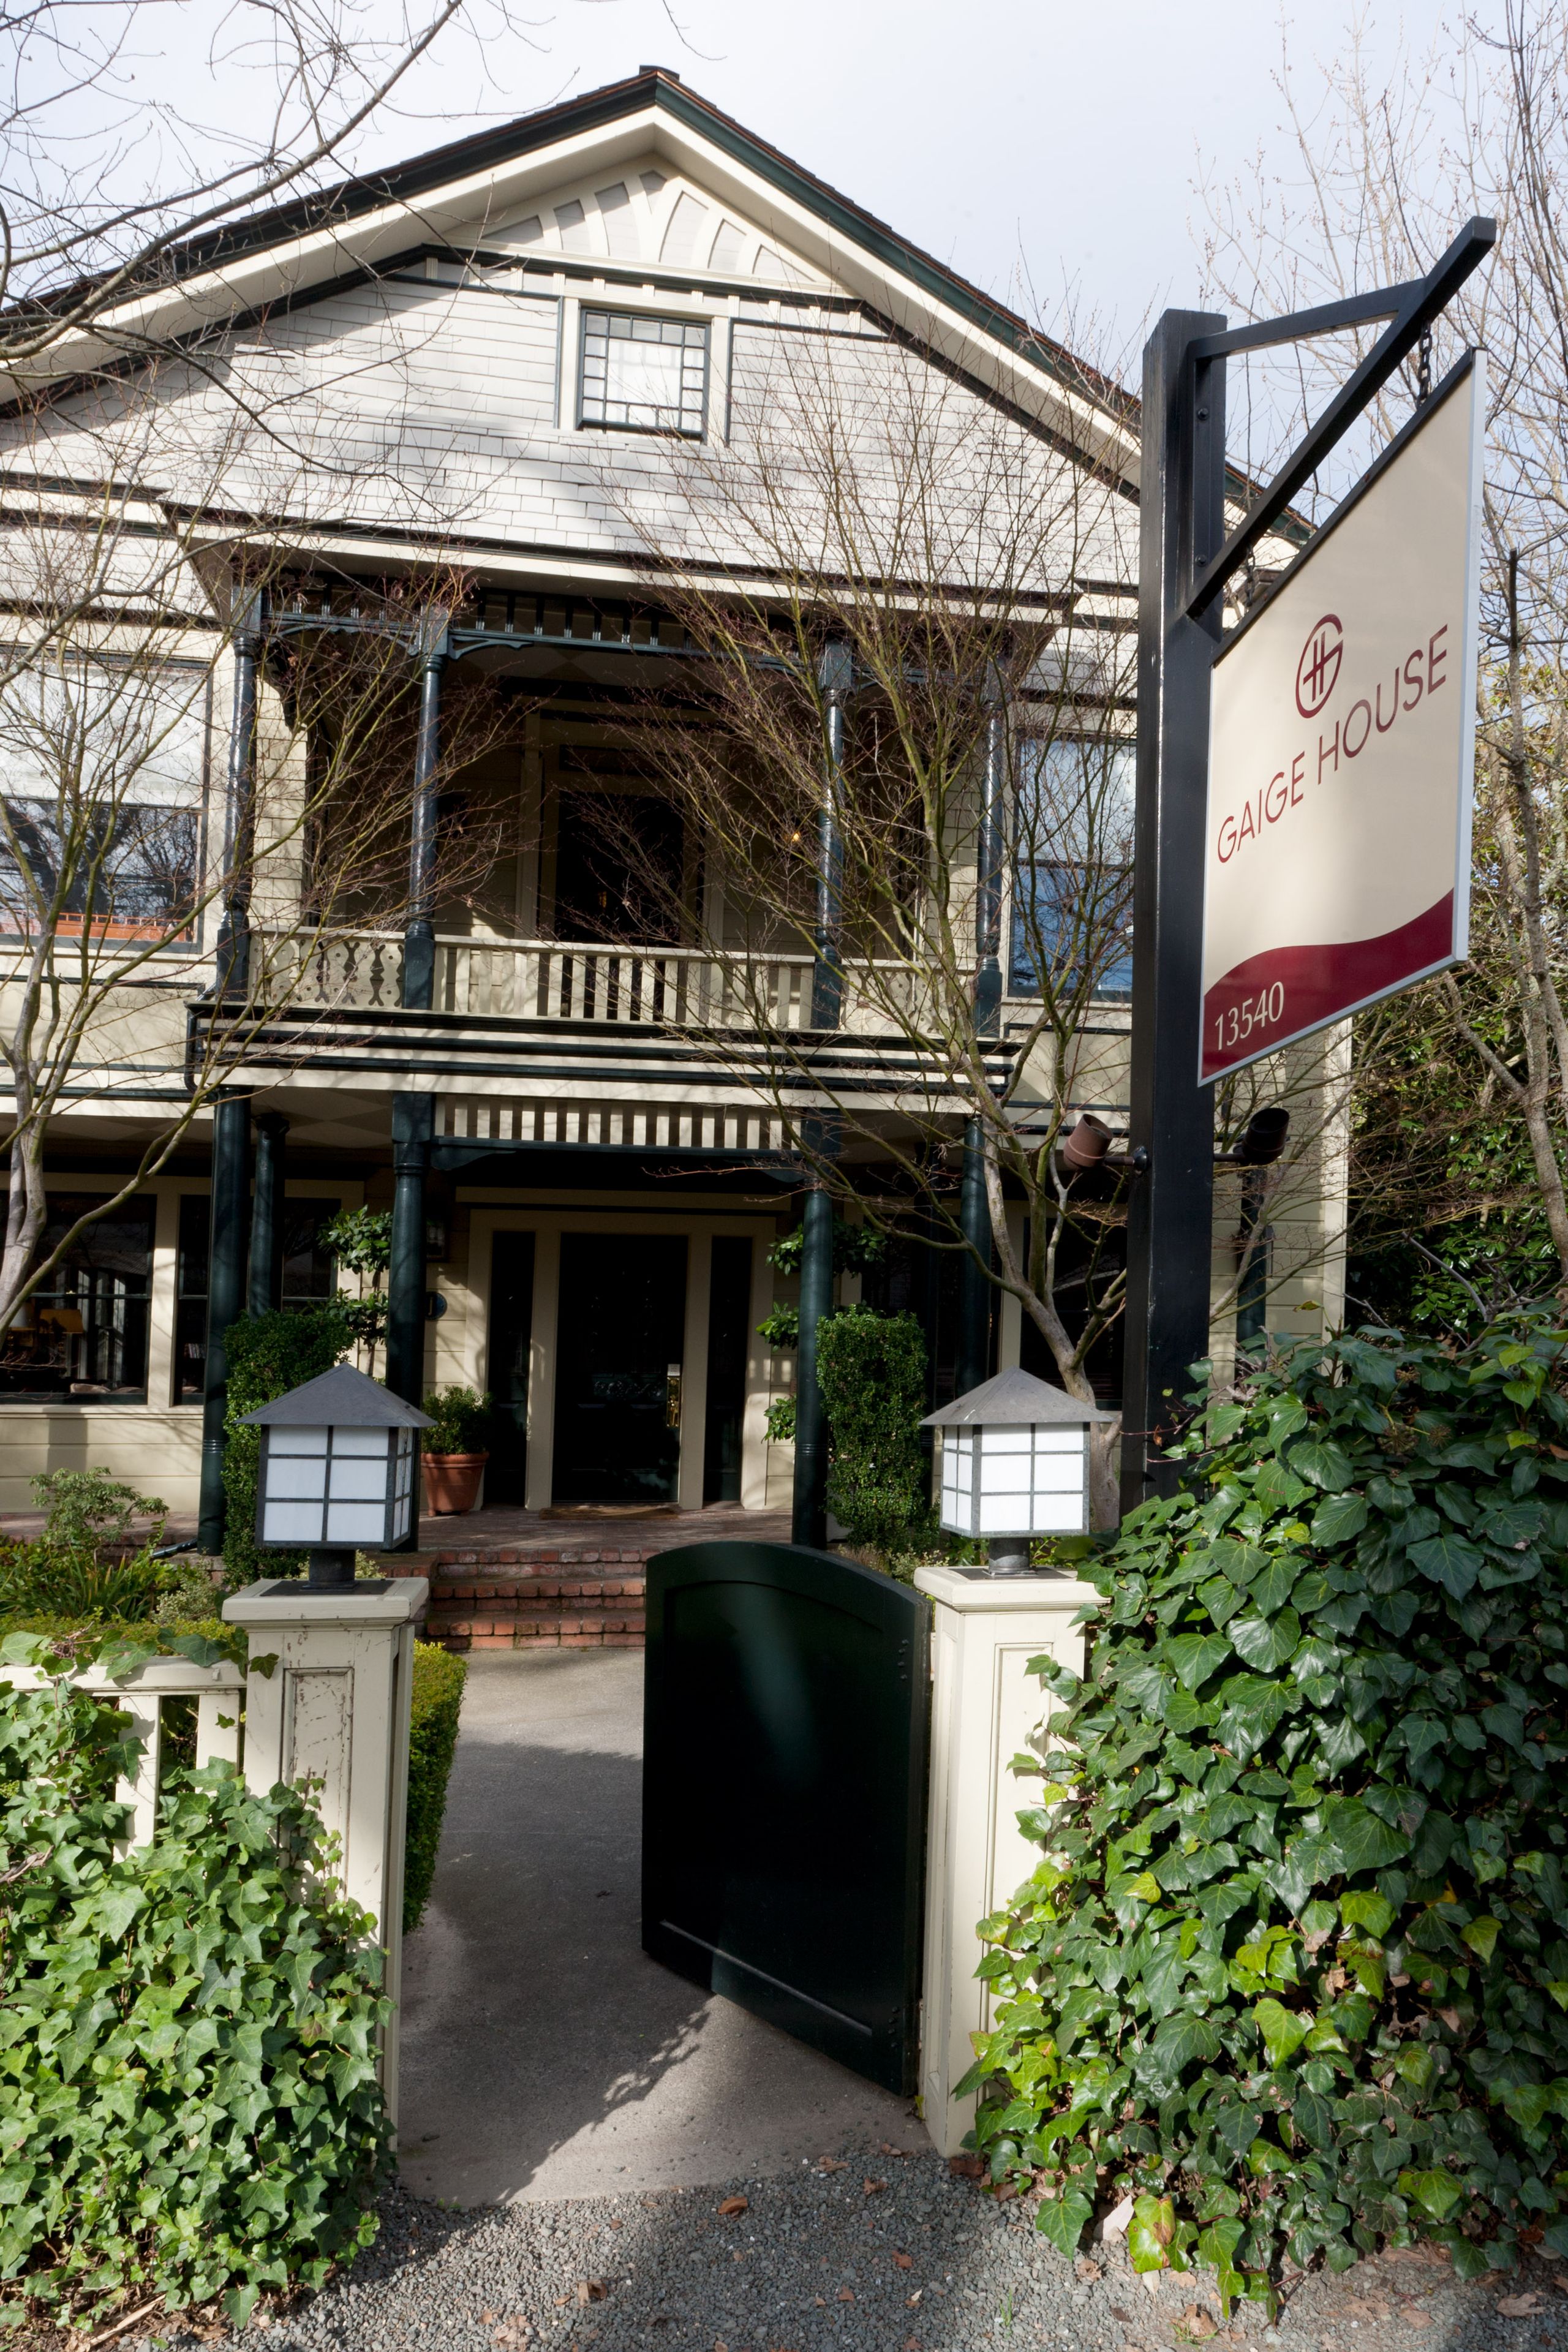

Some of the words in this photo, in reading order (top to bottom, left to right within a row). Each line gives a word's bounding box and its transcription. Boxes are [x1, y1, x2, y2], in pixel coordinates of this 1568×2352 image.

[1217, 751, 1305, 863] GAIGE
[1317, 624, 1448, 785] HOUSE
[1215, 981, 1284, 1051] 13540
